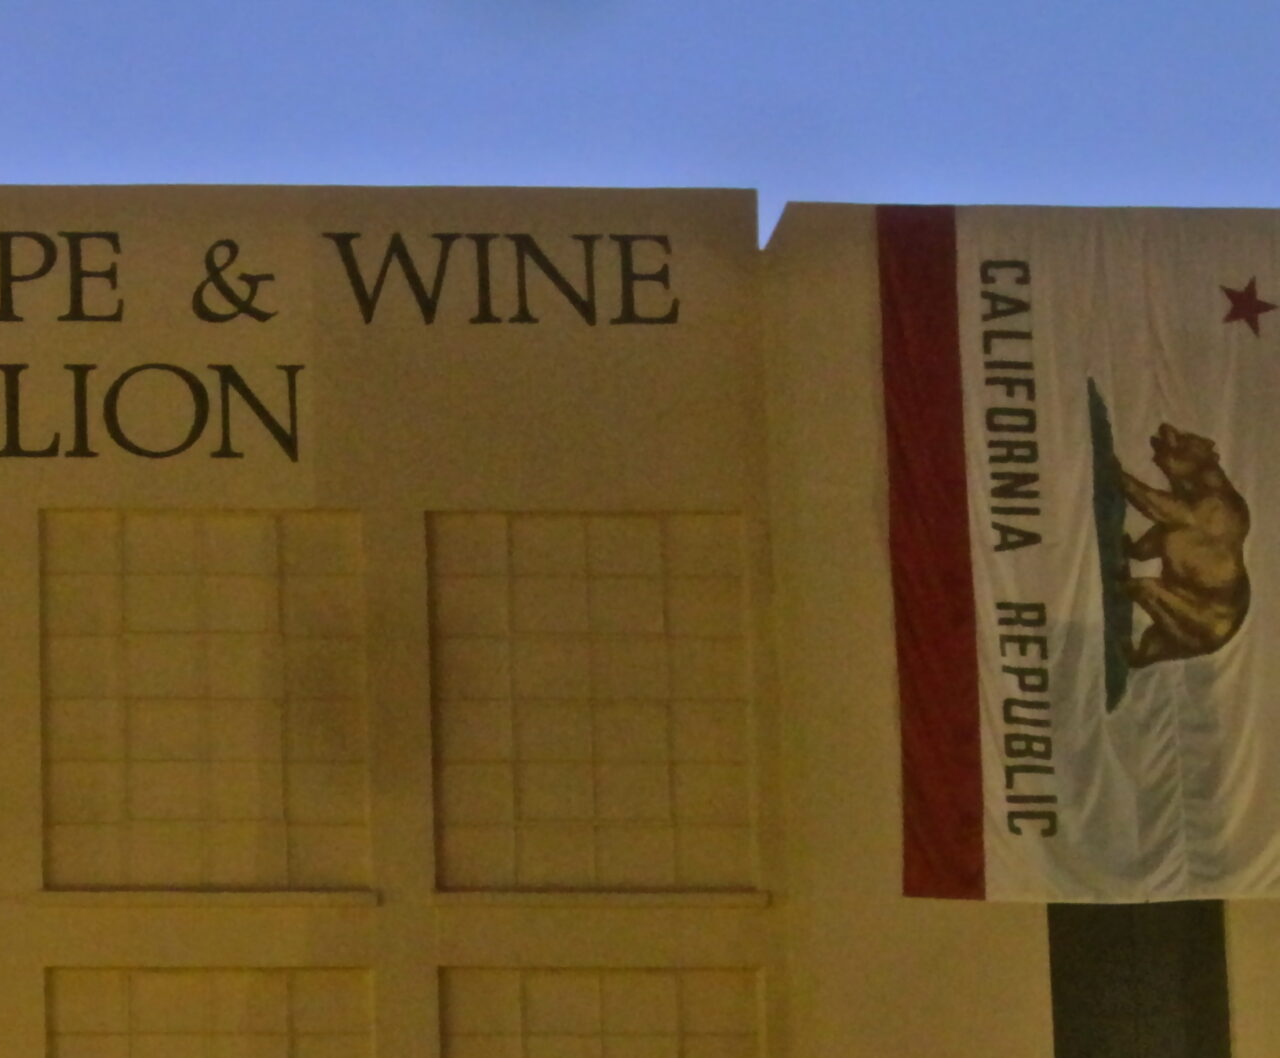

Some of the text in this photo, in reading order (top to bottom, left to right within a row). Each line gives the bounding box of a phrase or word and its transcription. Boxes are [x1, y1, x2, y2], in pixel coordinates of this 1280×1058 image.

[192, 239, 279, 324] &
[323, 232, 680, 326] WINE
[979, 259, 1059, 838] CALIFORNIA REPUBLIC
